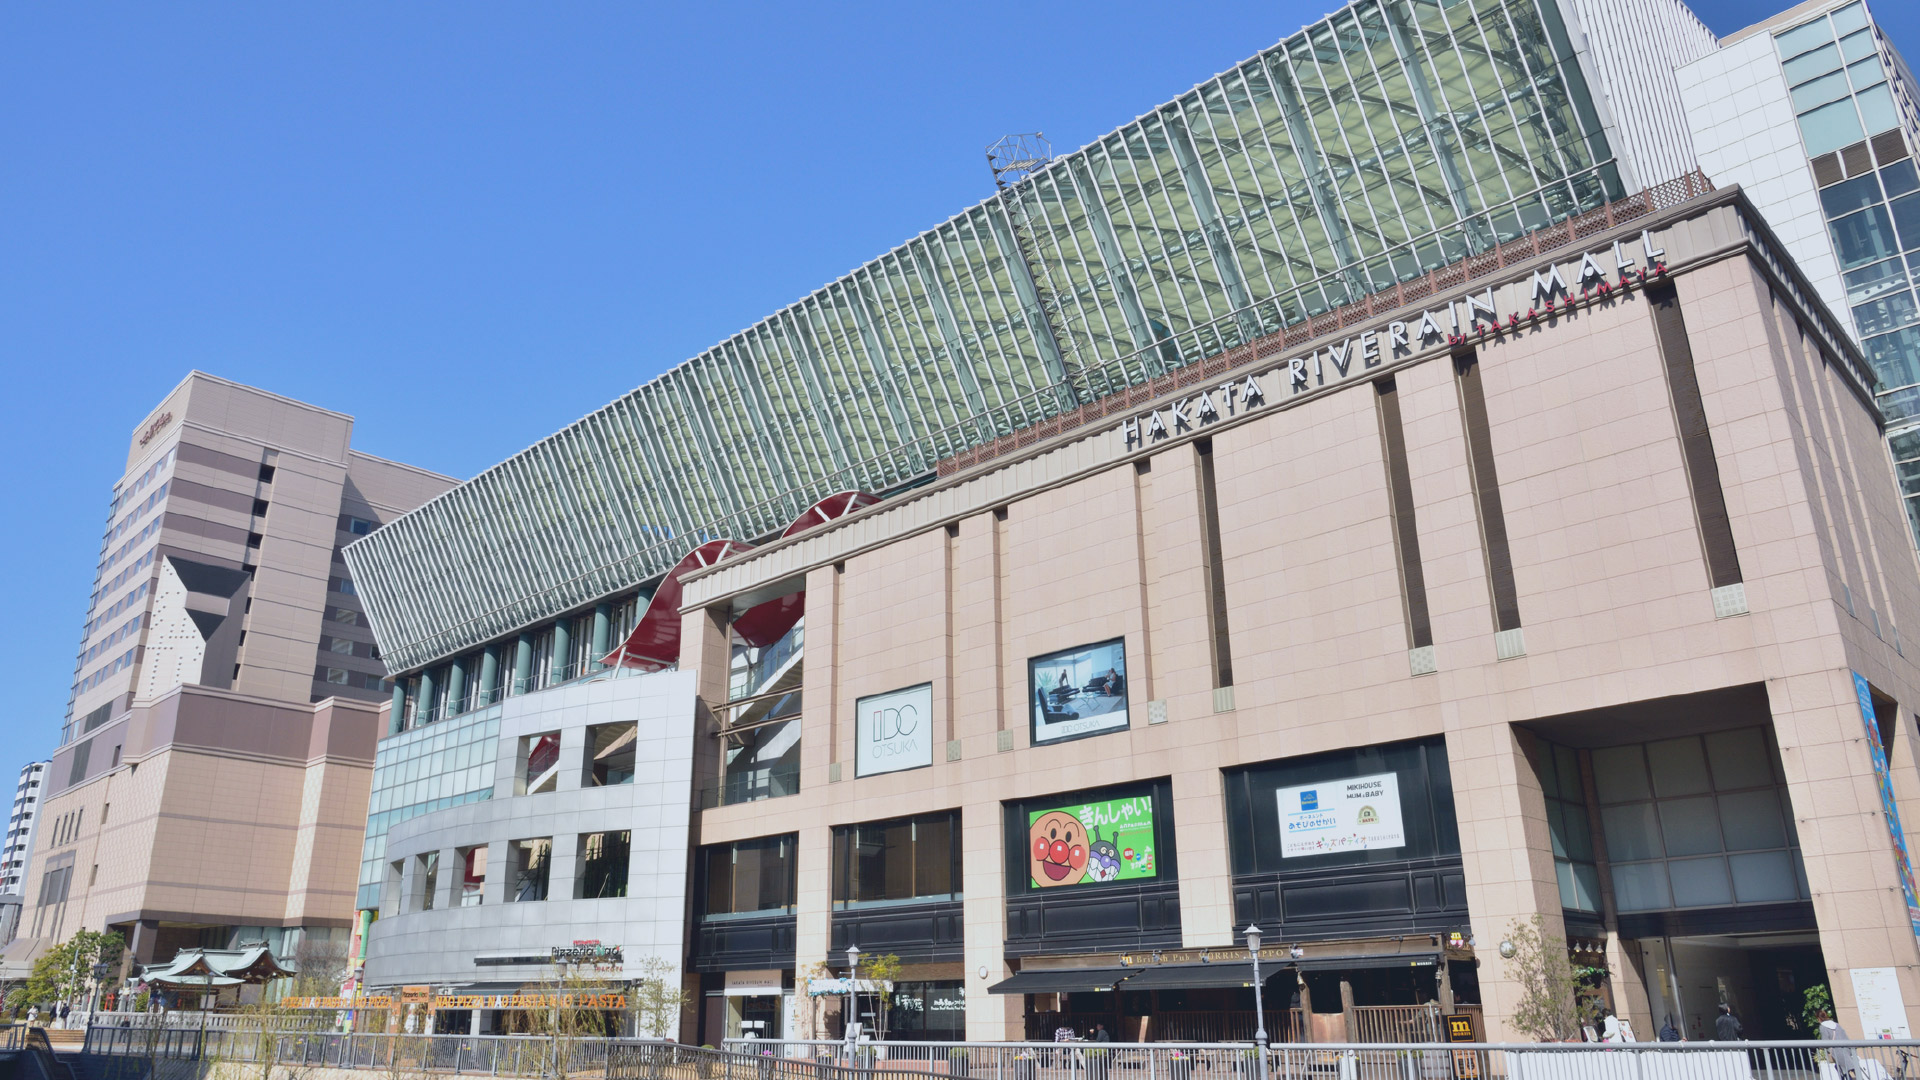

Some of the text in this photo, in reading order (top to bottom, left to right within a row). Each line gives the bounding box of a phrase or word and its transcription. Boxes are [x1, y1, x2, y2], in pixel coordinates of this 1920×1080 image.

[1447, 261, 1669, 347] by TAKASHIMAYA
[1122, 229, 1666, 444] HAKATA RIVERAIN MALL
[872, 703, 918, 743] IDC
[1073, 719, 1101, 732] OTSUKA
[871, 738, 919, 759] OTSUKA
[1346, 780, 1382, 791] MIKIHOUSE
[1288, 817, 1336, 830] あそびのせかい
[551, 945, 620, 957] Pizzeria Nao
[1172, 953, 1190, 962] Pub
[368, 996, 392, 1009] PIZZA
[435, 994, 455, 1009] NAO
[457, 994, 485, 1009] PIZZA
[487, 994, 509, 1009] NAO
[510, 994, 547, 1009] PASTA
[578, 994, 627, 1009] PASTA
[1451, 1020, 1471, 1033] m
